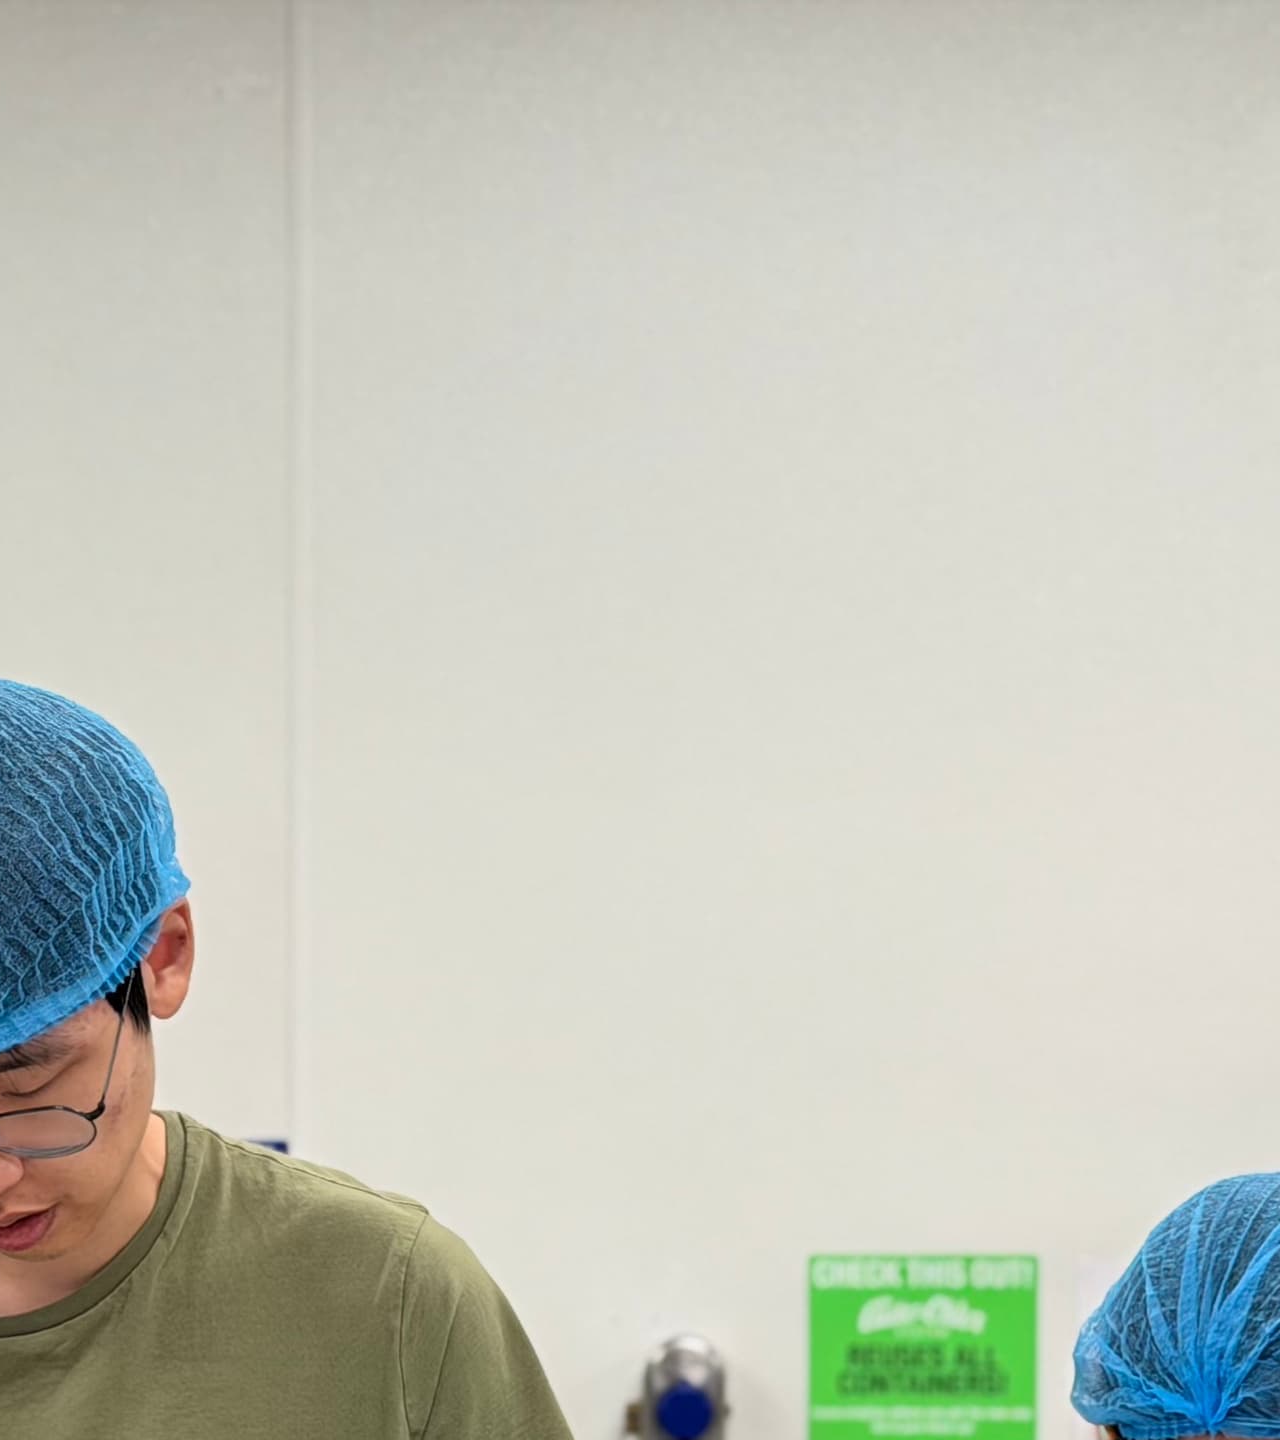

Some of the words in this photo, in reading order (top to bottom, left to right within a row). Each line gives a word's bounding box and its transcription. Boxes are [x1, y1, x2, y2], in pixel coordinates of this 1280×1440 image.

[812, 1259, 901, 1289] CHECK
[906, 1259, 967, 1289] THIS
[847, 1344, 943, 1366] REUSES
